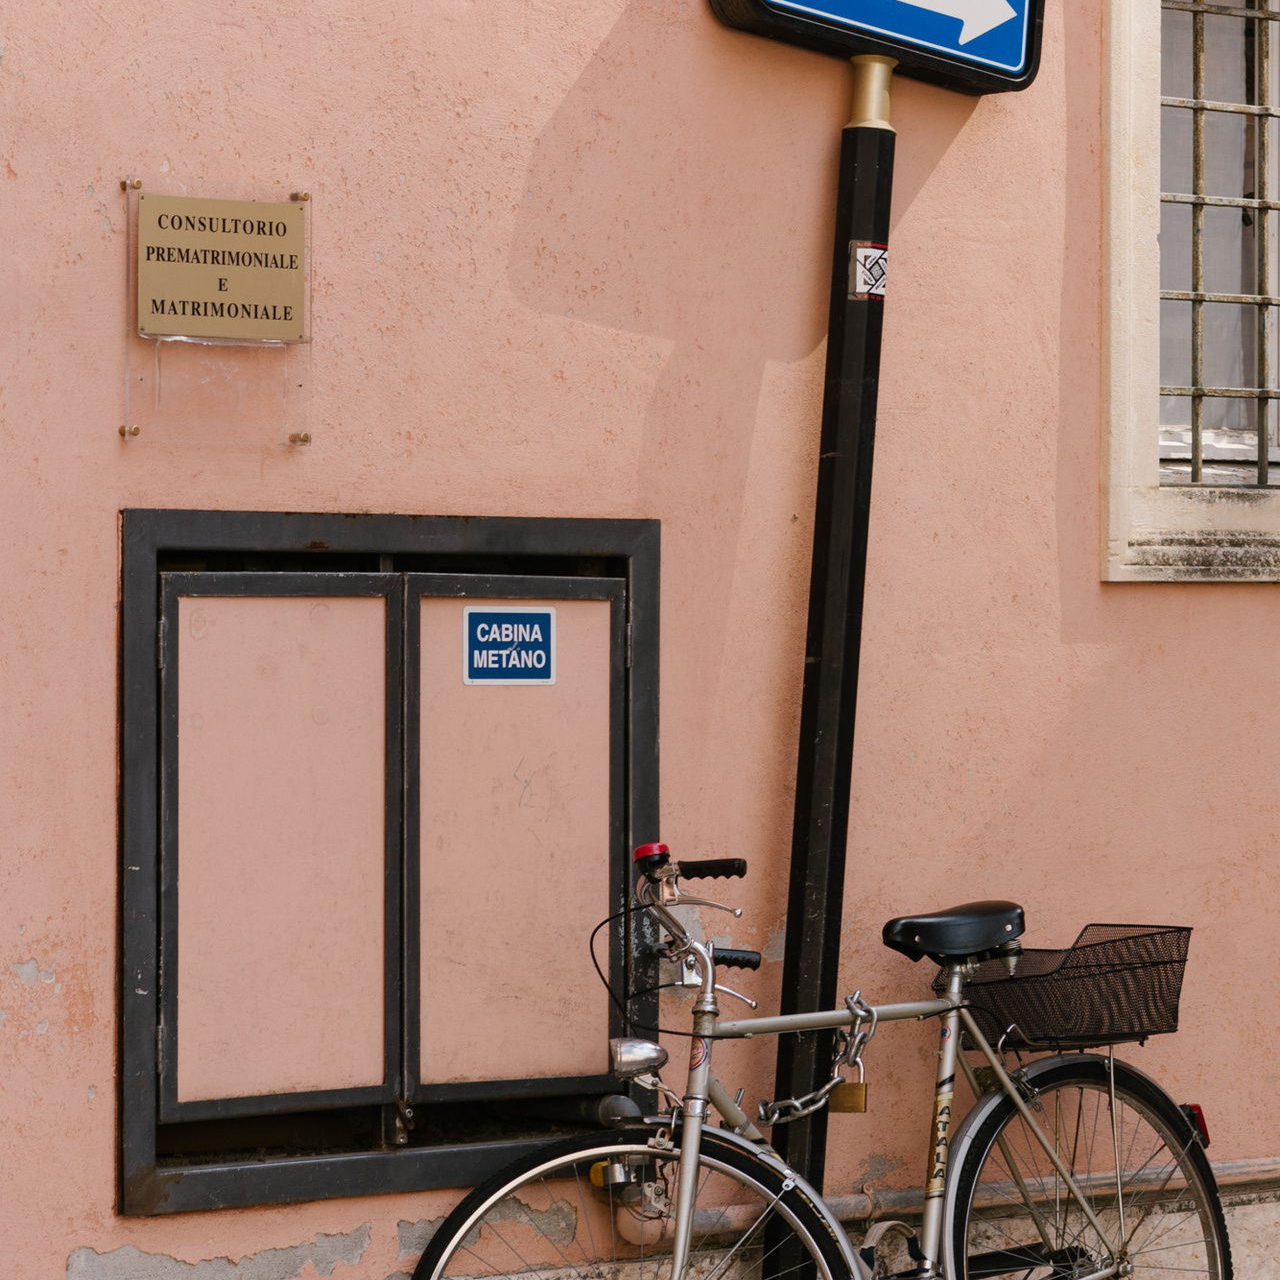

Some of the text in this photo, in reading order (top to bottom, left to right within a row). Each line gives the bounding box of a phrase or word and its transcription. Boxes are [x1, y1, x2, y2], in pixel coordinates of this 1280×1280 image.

[158, 214, 286, 237] CONSULTORIO
[146, 246, 298, 269] PREMATRIMONIALE
[218, 278, 228, 292] E
[151, 299, 293, 321] MATRIMONIALE
[476, 623, 543, 642] CABINA
[473, 650, 546, 669] METANO
[932, 1105, 951, 1179] ATALA
